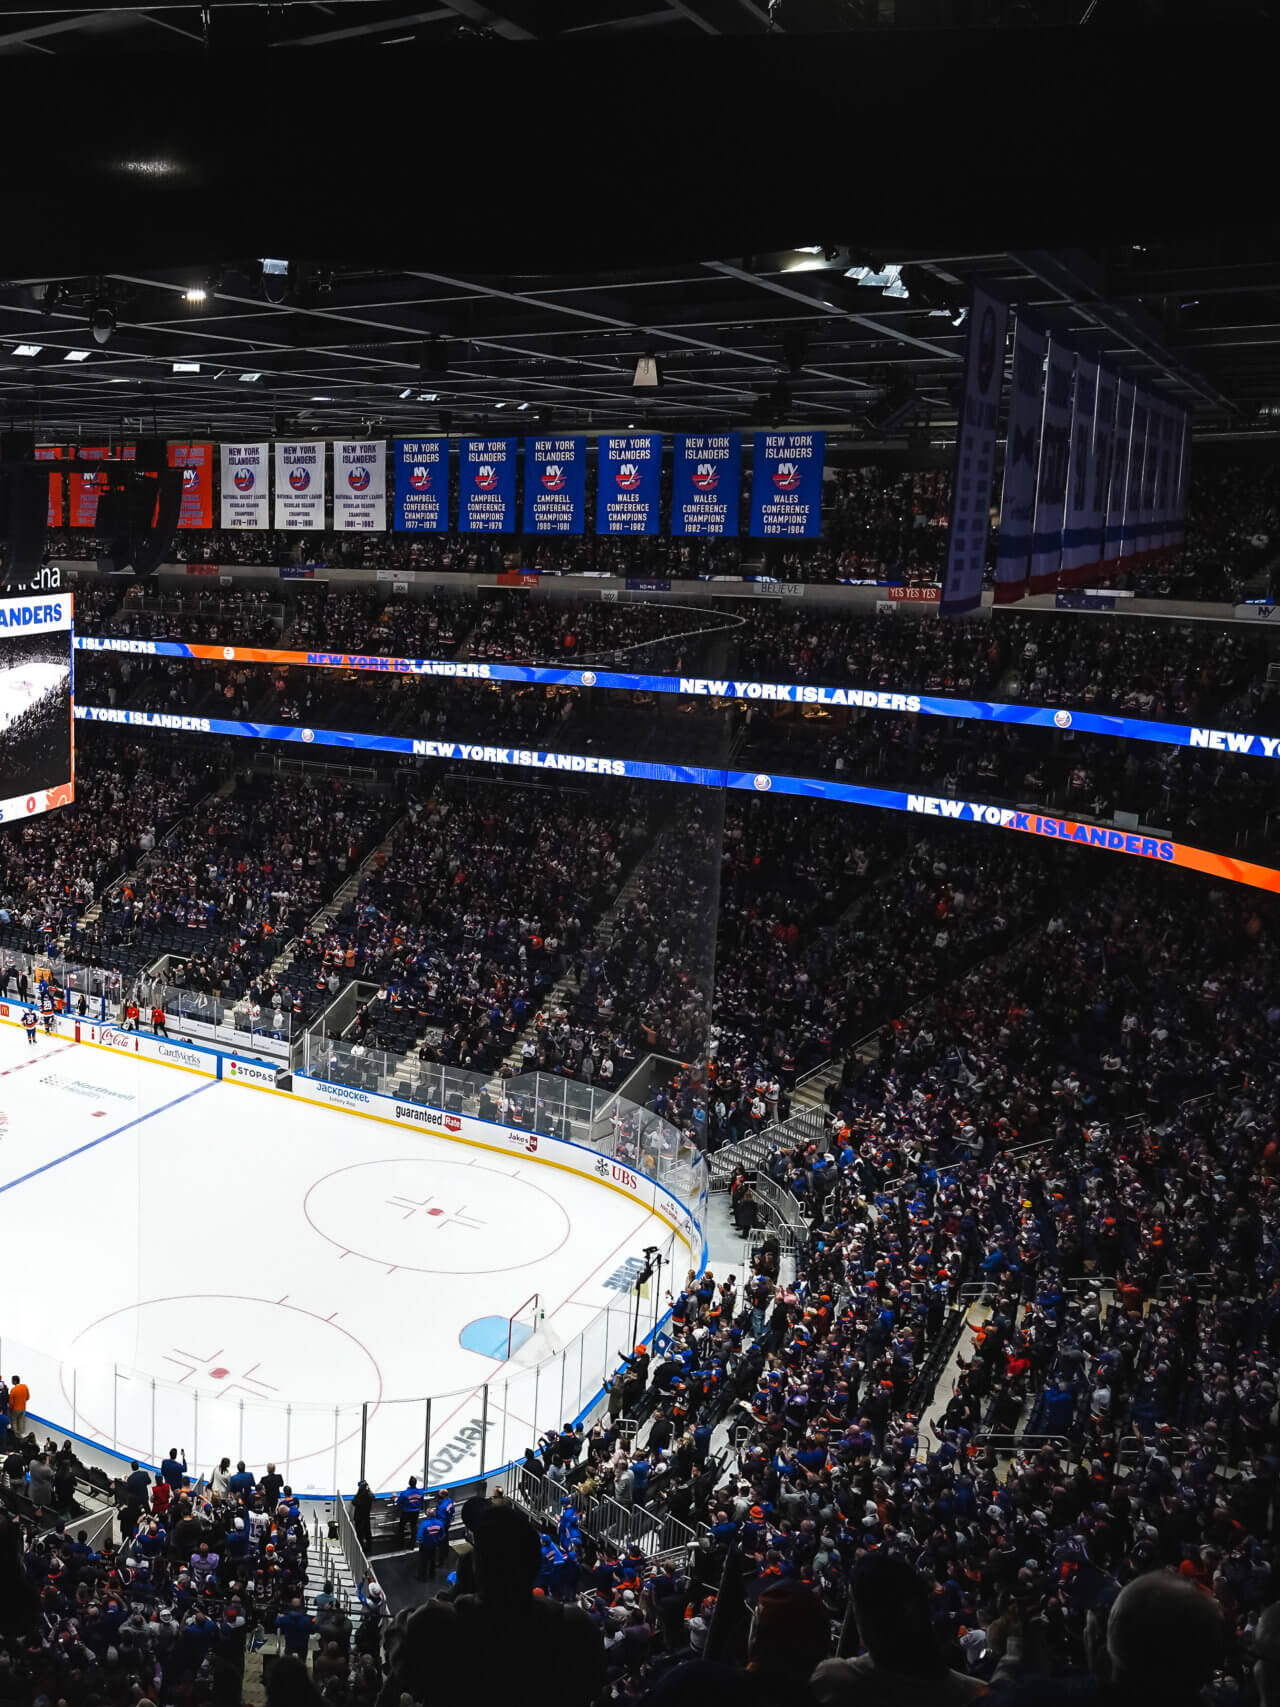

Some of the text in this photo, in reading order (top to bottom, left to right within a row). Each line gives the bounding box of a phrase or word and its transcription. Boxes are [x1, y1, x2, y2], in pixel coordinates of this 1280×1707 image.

[609, 438, 651, 449] NEW YORK
[685, 437, 730, 448] NEW YORK
[766, 435, 812, 446] NEW YORK
[360, 445, 376, 453] YORK
[404, 443, 439, 452] NEW YORK
[469, 442, 506, 451] NEW YORK
[535, 441, 575, 450] NEW YORK
[229, 447, 260, 456] NEW YORK
[284, 446, 316, 455] NEW YORK
[609, 450, 651, 460] ISLANDERS
[685, 449, 730, 460] ISLANDERS
[765, 448, 812, 458] ISLANDERS
[229, 457, 260, 465] ISLANDERS
[284, 456, 316, 464] ISLANDERS
[343, 455, 376, 463] ISLANDERS
[404, 453, 439, 463] ISLANDERS
[469, 452, 506, 461] ISLANDERS
[535, 452, 575, 461] ISLANDERS
[617, 494, 639, 502] WALES
[693, 495, 717, 503] WALES
[774, 495, 798, 503] WALES
[403, 503, 439, 511] CONFERENCE
[533, 504, 574, 512] CONFERENCE
[607, 503, 649, 512] CONFERENCE
[683, 505, 727, 513] CONFERENCE
[762, 505, 809, 513] CONFERENCE
[405, 512, 438, 520] CHAMPIONS
[469, 512, 504, 520] CHAMPIONS
[535, 513, 572, 521] CHAMPIONS
[609, 513, 647, 521] CHAMPIONS
[684, 515, 725, 523] CHAMPIONS
[763, 515, 807, 524] CHAMPIONS
[761, 582, 799, 594] BELIEVE
[890, 587, 936, 599] YES YES YES
[82, 638, 156, 654] ISLANDERS
[308, 653, 491, 679] NEW YORK ISLANDERS
[680, 678, 920, 713] NEW YORK ISLANDERS
[91, 708, 127, 723] YORK
[129, 711, 210, 732] ISLANDERS
[1190, 728, 1254, 753] NEW
[412, 739, 626, 776] NEW YORK ISLANDERS
[26, 796, 36, 813] 0
[907, 794, 1175, 861] NEW YORK ISLANDERS
[158, 1045, 201, 1065] CardWorks
[395, 1104, 461, 1129] guaranteed Rate
[611, 1165, 638, 1190] UBS
